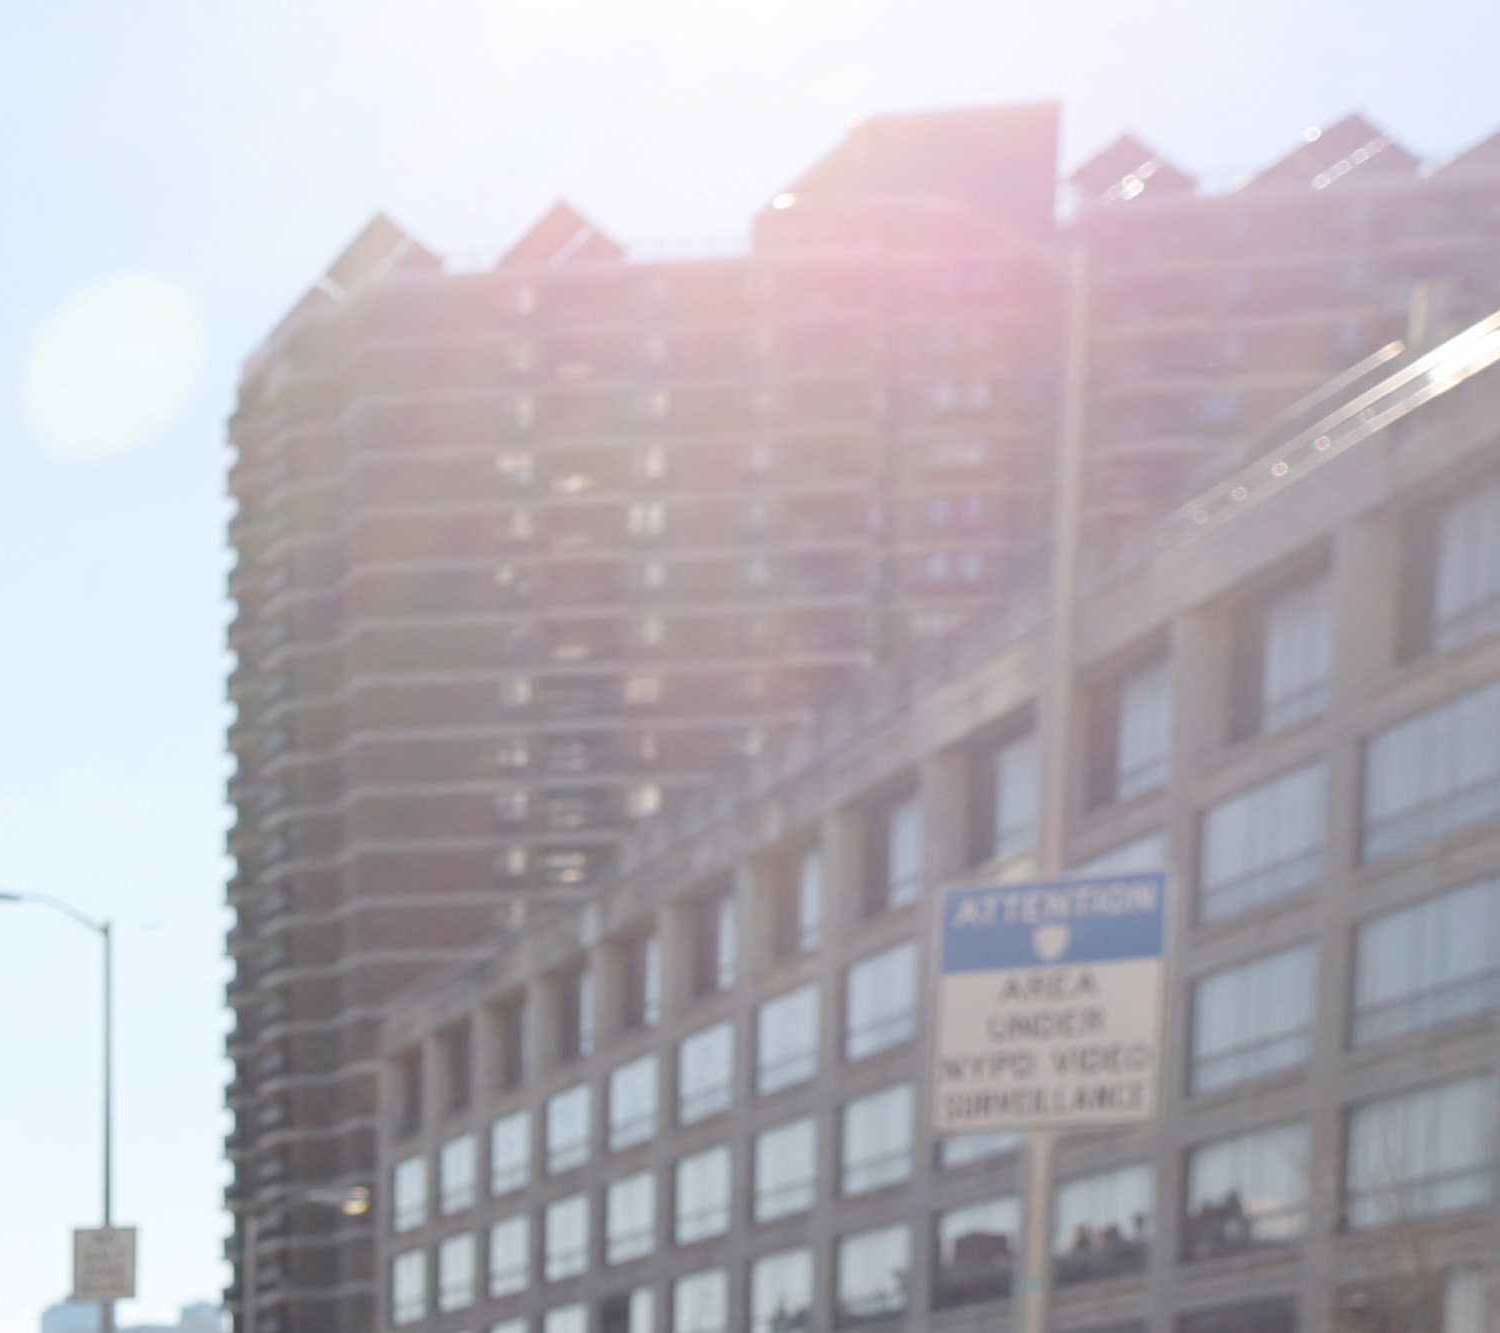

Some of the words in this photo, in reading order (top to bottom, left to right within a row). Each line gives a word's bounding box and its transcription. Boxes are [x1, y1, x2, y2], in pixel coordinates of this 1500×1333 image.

[953, 882, 1157, 929] ATTENTION
[998, 967, 1099, 1001] AREA
[986, 1006, 1105, 1043] UNDER
[943, 1051, 1038, 1081] NYPD
[1052, 1043, 1152, 1076] VIDEO
[946, 1080, 1144, 1121] SURVEILLANCE
